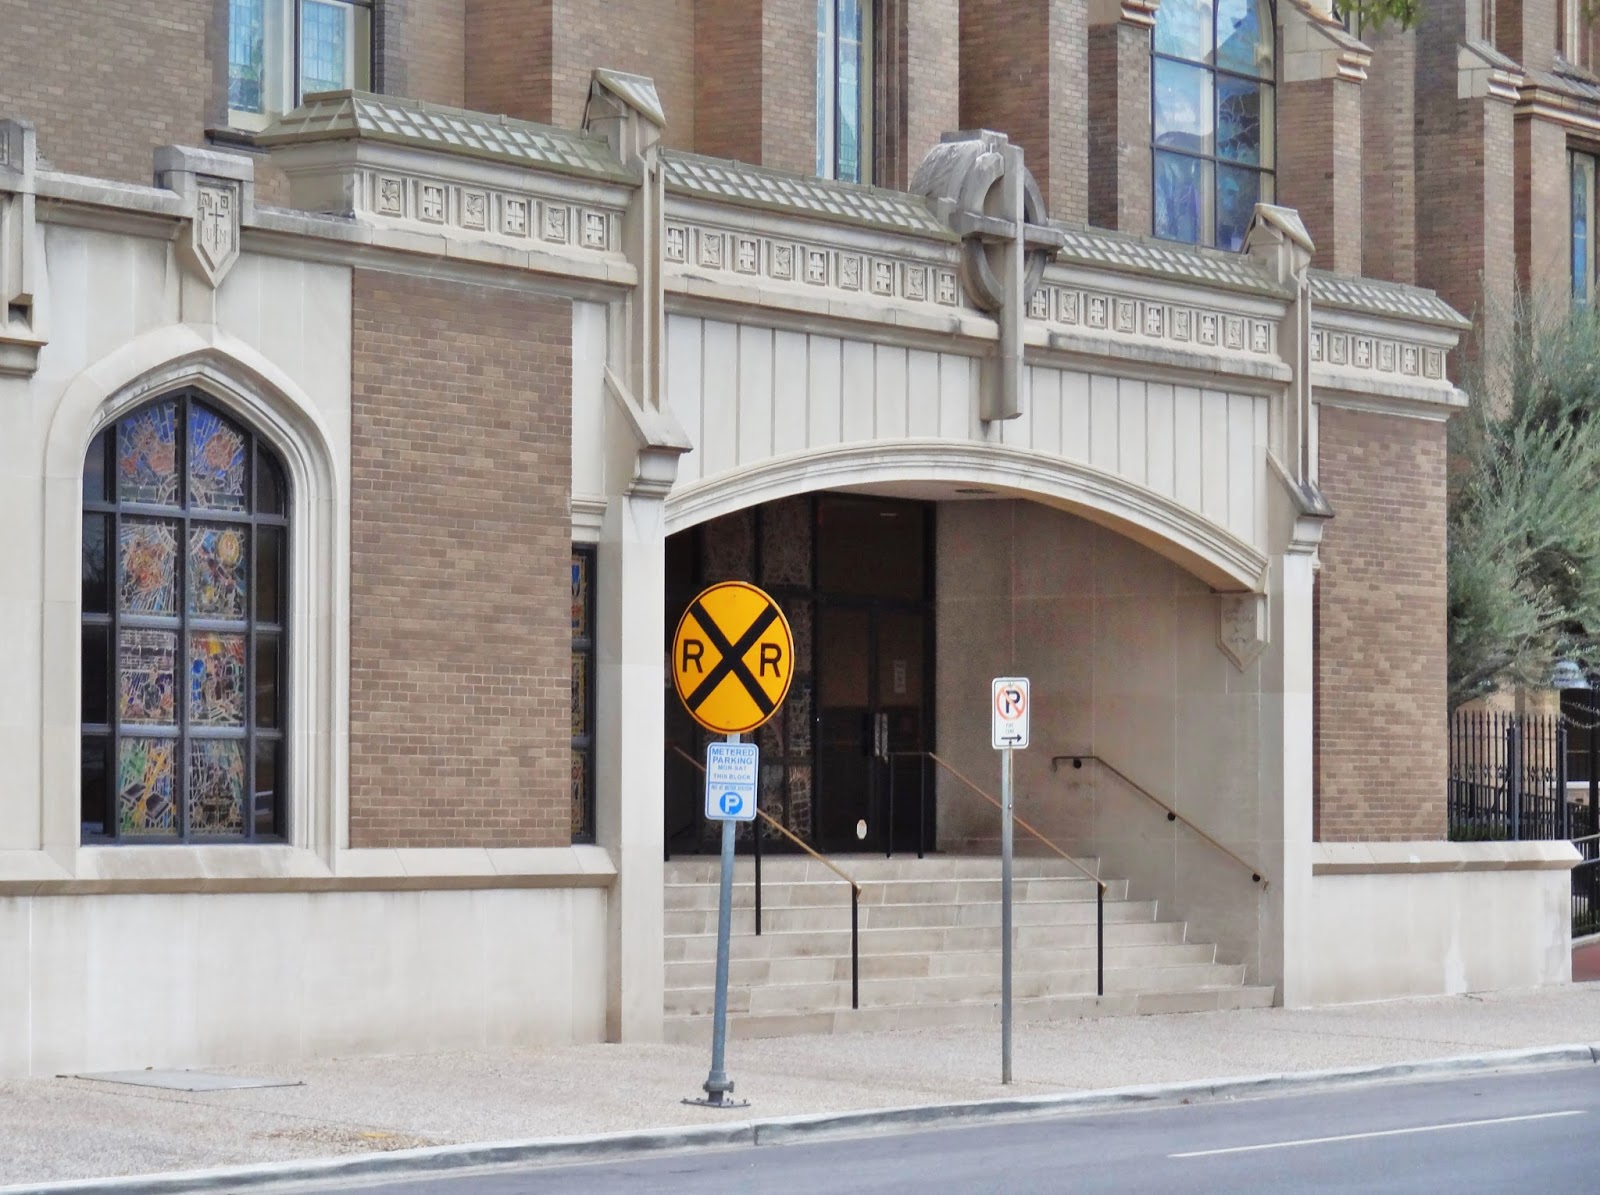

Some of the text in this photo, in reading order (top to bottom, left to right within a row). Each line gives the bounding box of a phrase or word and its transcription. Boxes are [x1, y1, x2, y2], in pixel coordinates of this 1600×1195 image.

[682, 638, 783, 678] R R
[712, 748, 754, 757] METERED
[712, 756, 753, 765] PARKING
